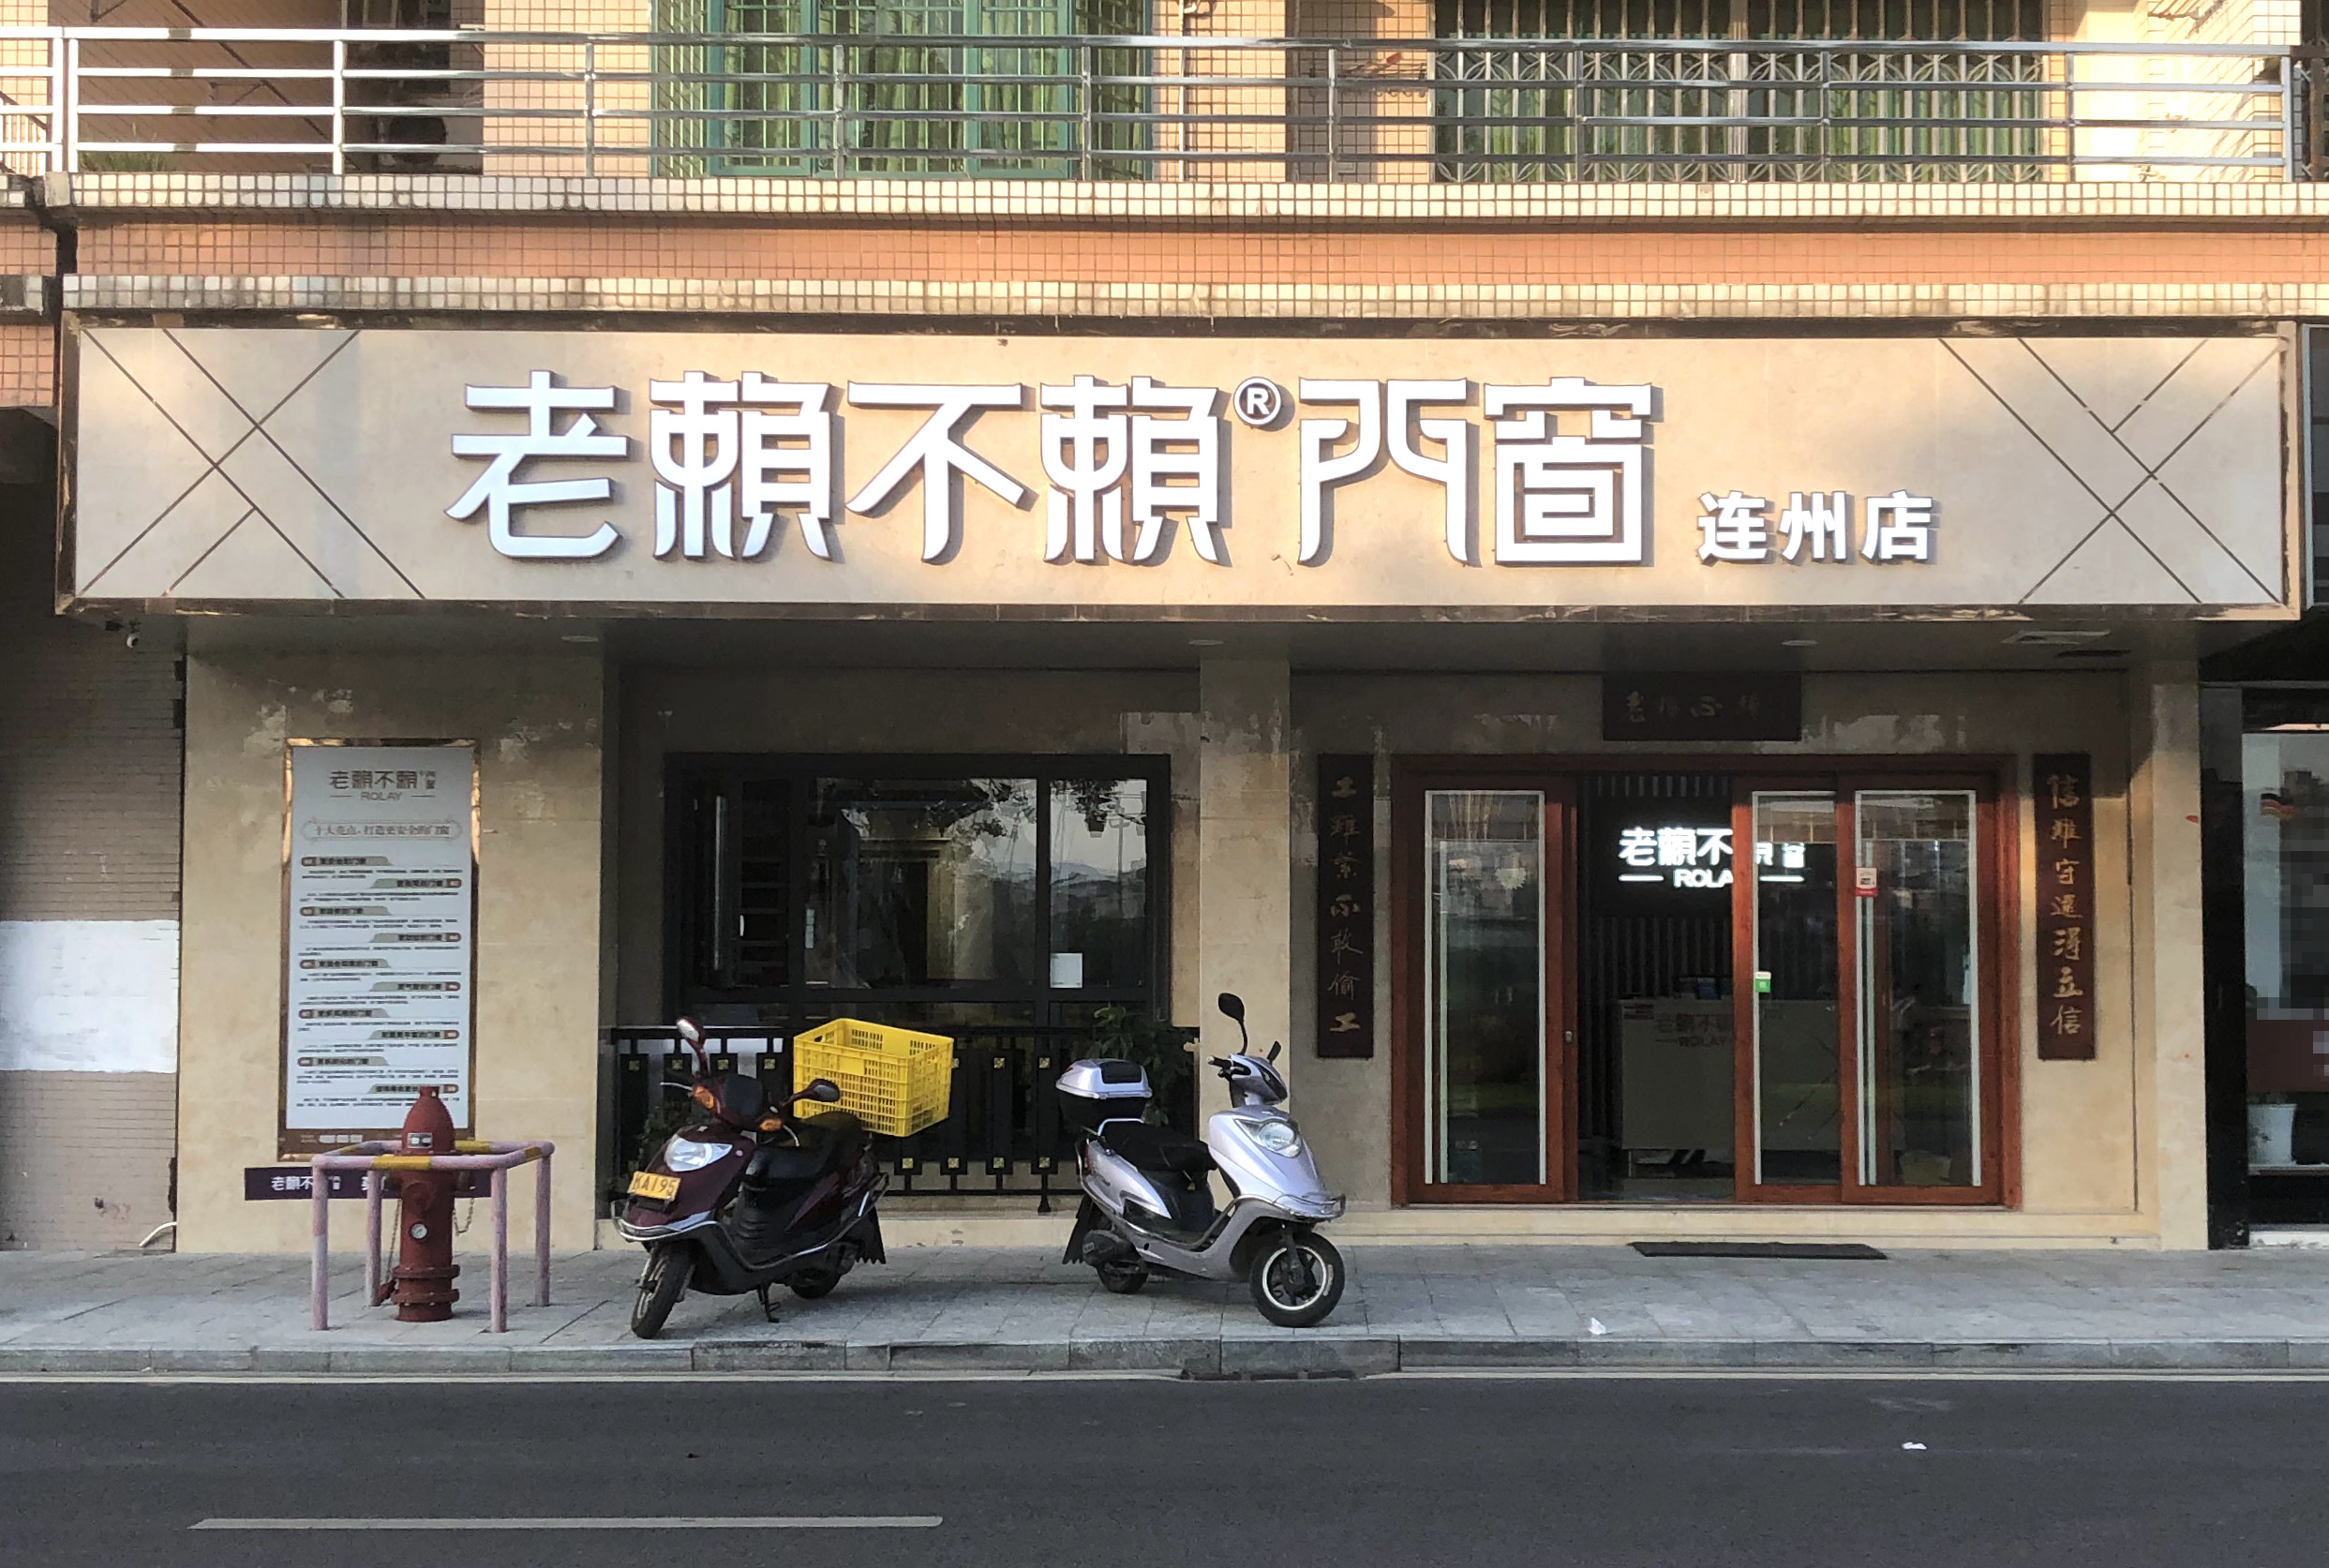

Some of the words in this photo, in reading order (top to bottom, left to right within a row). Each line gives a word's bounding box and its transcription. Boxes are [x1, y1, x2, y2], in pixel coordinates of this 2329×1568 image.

[1697, 490, 1934, 562] 连州店
[360, 791, 403, 801] ROLAY
[1673, 868, 1734, 889] ROLA
